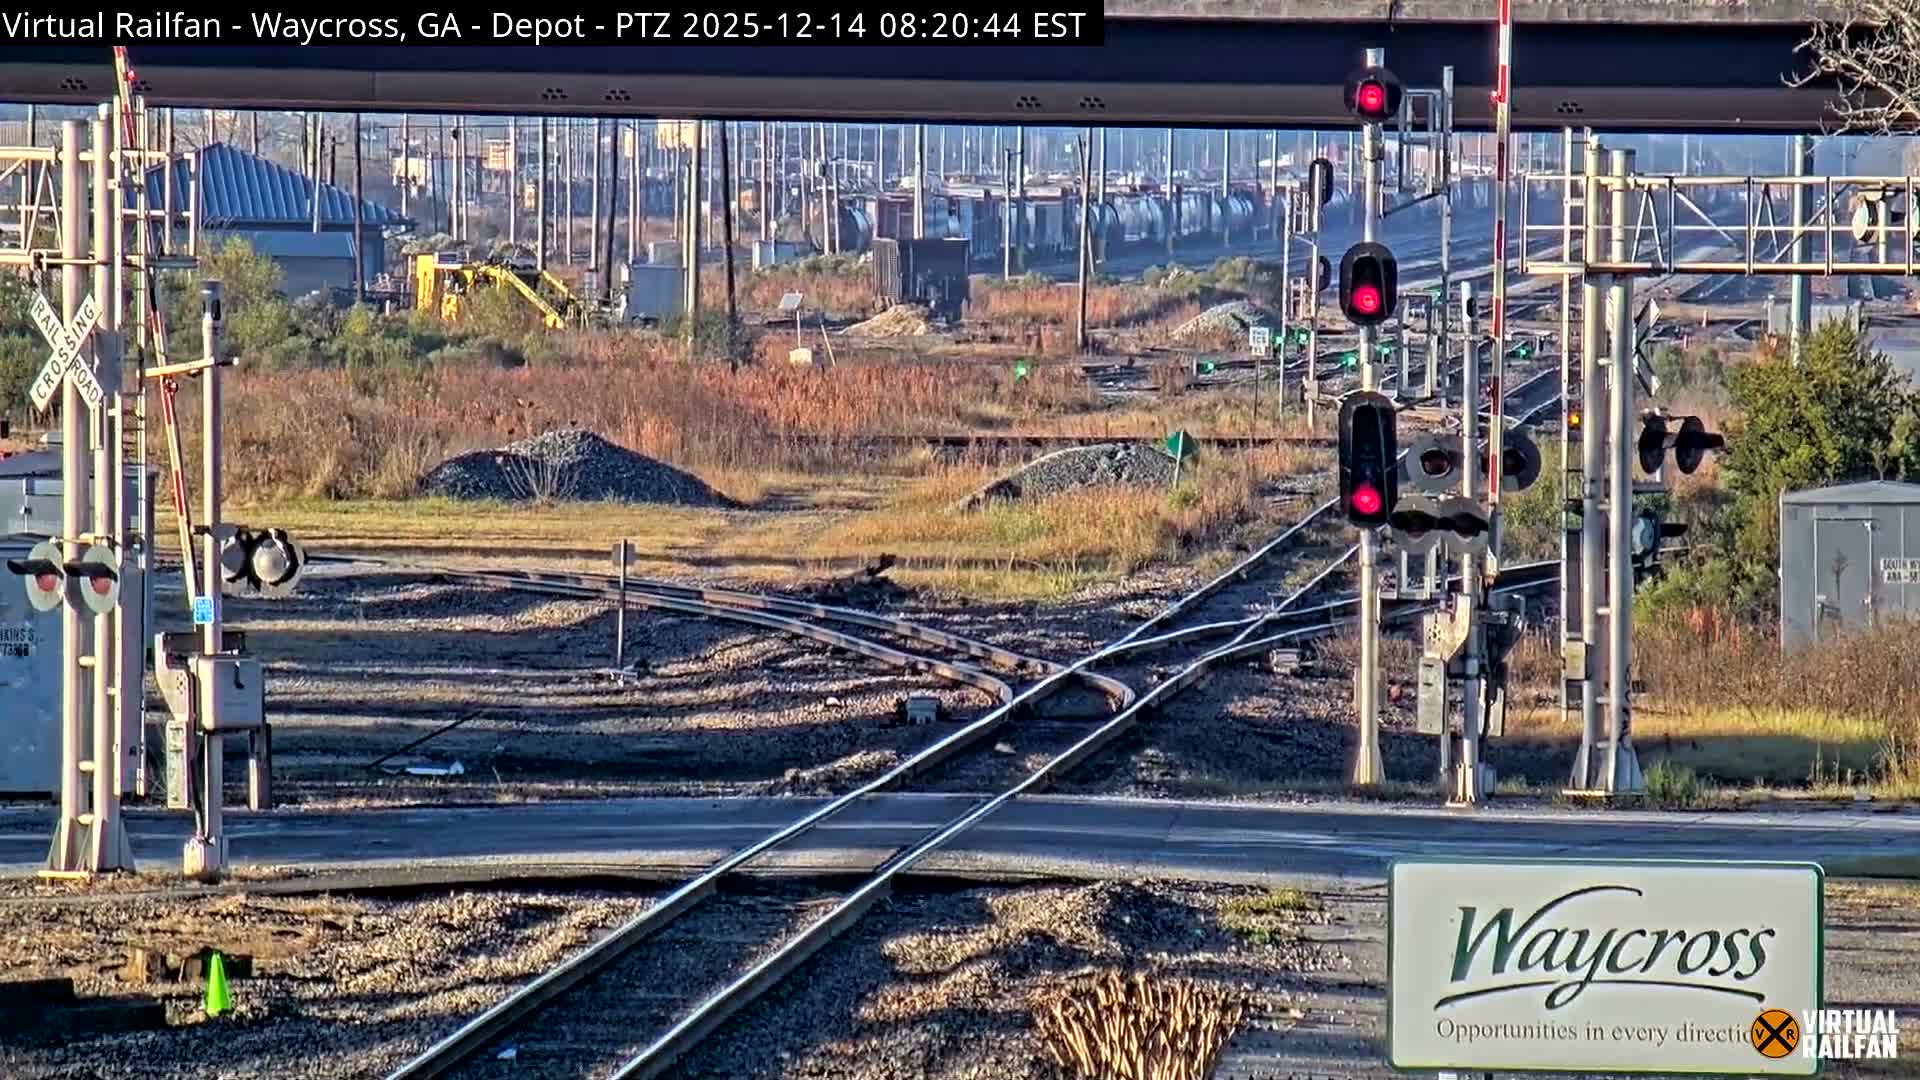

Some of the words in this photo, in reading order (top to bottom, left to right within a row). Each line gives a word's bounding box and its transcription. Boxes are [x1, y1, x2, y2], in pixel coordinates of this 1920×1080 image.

[33, 301, 60, 345] RAIL
[70, 358, 99, 402] ROAD
[36, 304, 95, 399] CROSSING
[1450, 885, 1776, 1010] Waycross
[1436, 1019, 1577, 1041] Opportunities
[1585, 1021, 1604, 1041] in
[1612, 1027, 1668, 1047] every
[1676, 1022, 1752, 1043] directio
